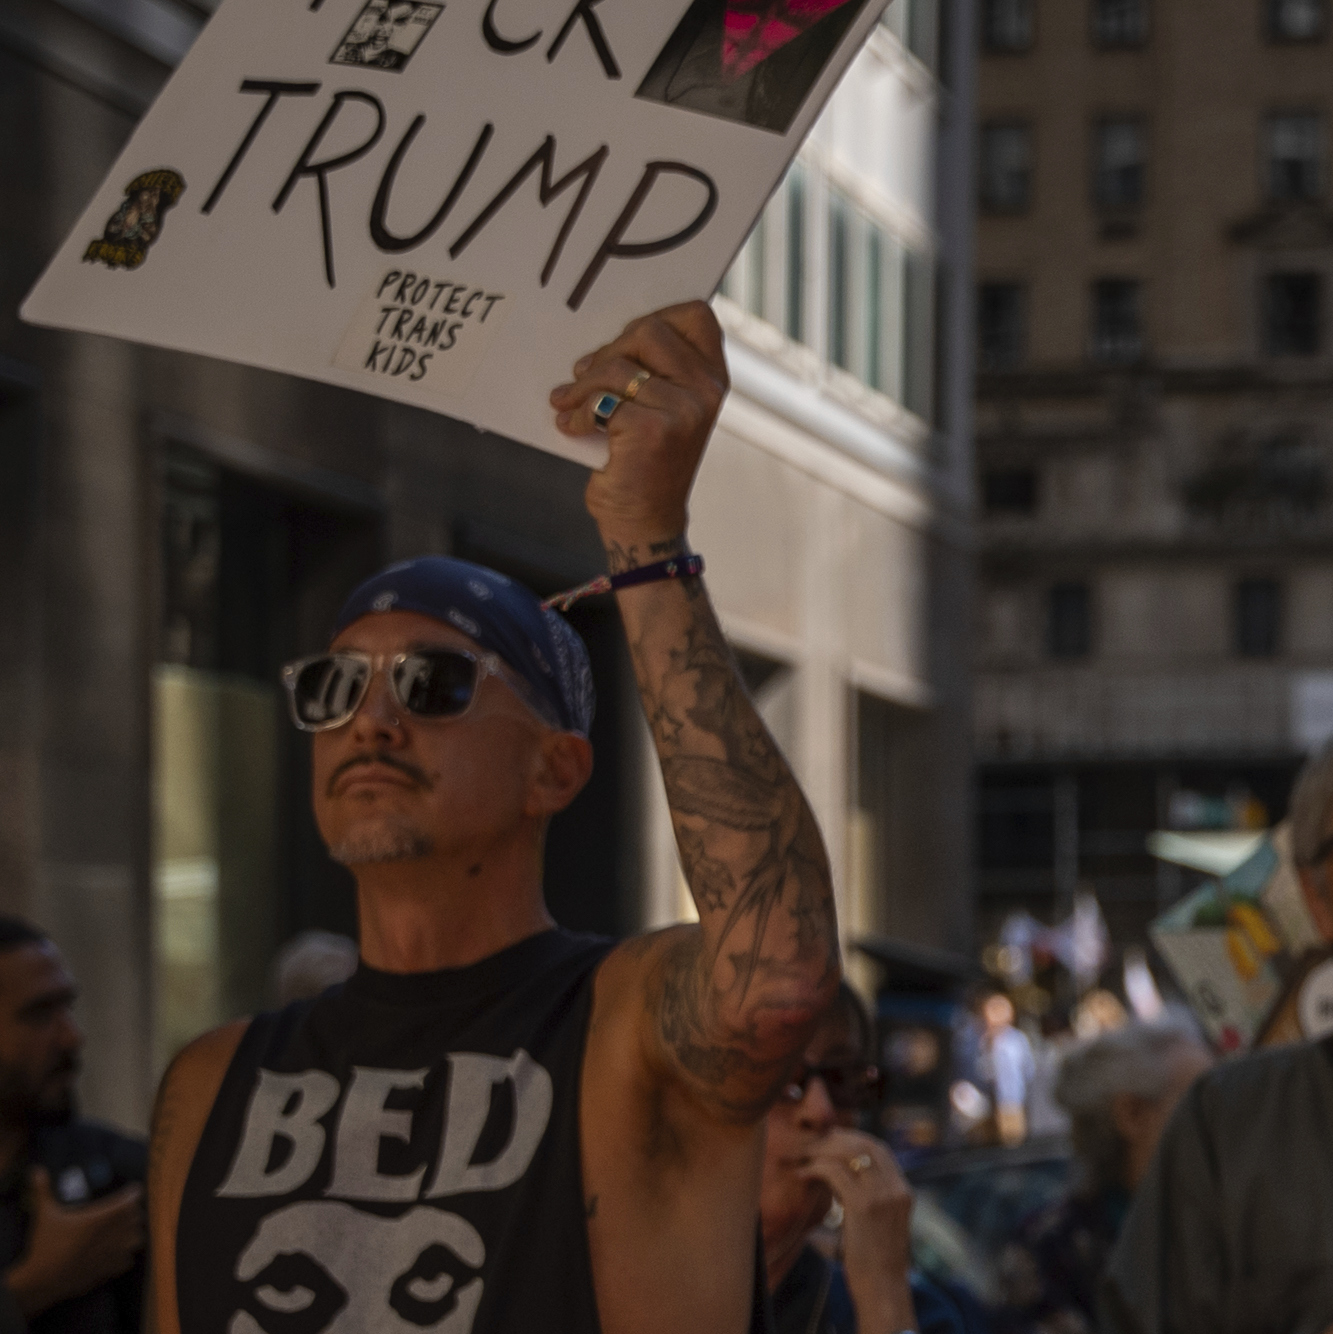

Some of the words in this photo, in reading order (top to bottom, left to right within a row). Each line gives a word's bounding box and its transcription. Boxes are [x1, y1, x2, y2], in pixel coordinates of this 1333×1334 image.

[201, 78, 718, 312] TRUMP
[376, 270, 505, 323] PROTECT
[376, 307, 463, 350] TRANS
[364, 340, 434, 381] KIDS
[214, 1047, 554, 1200] BED
